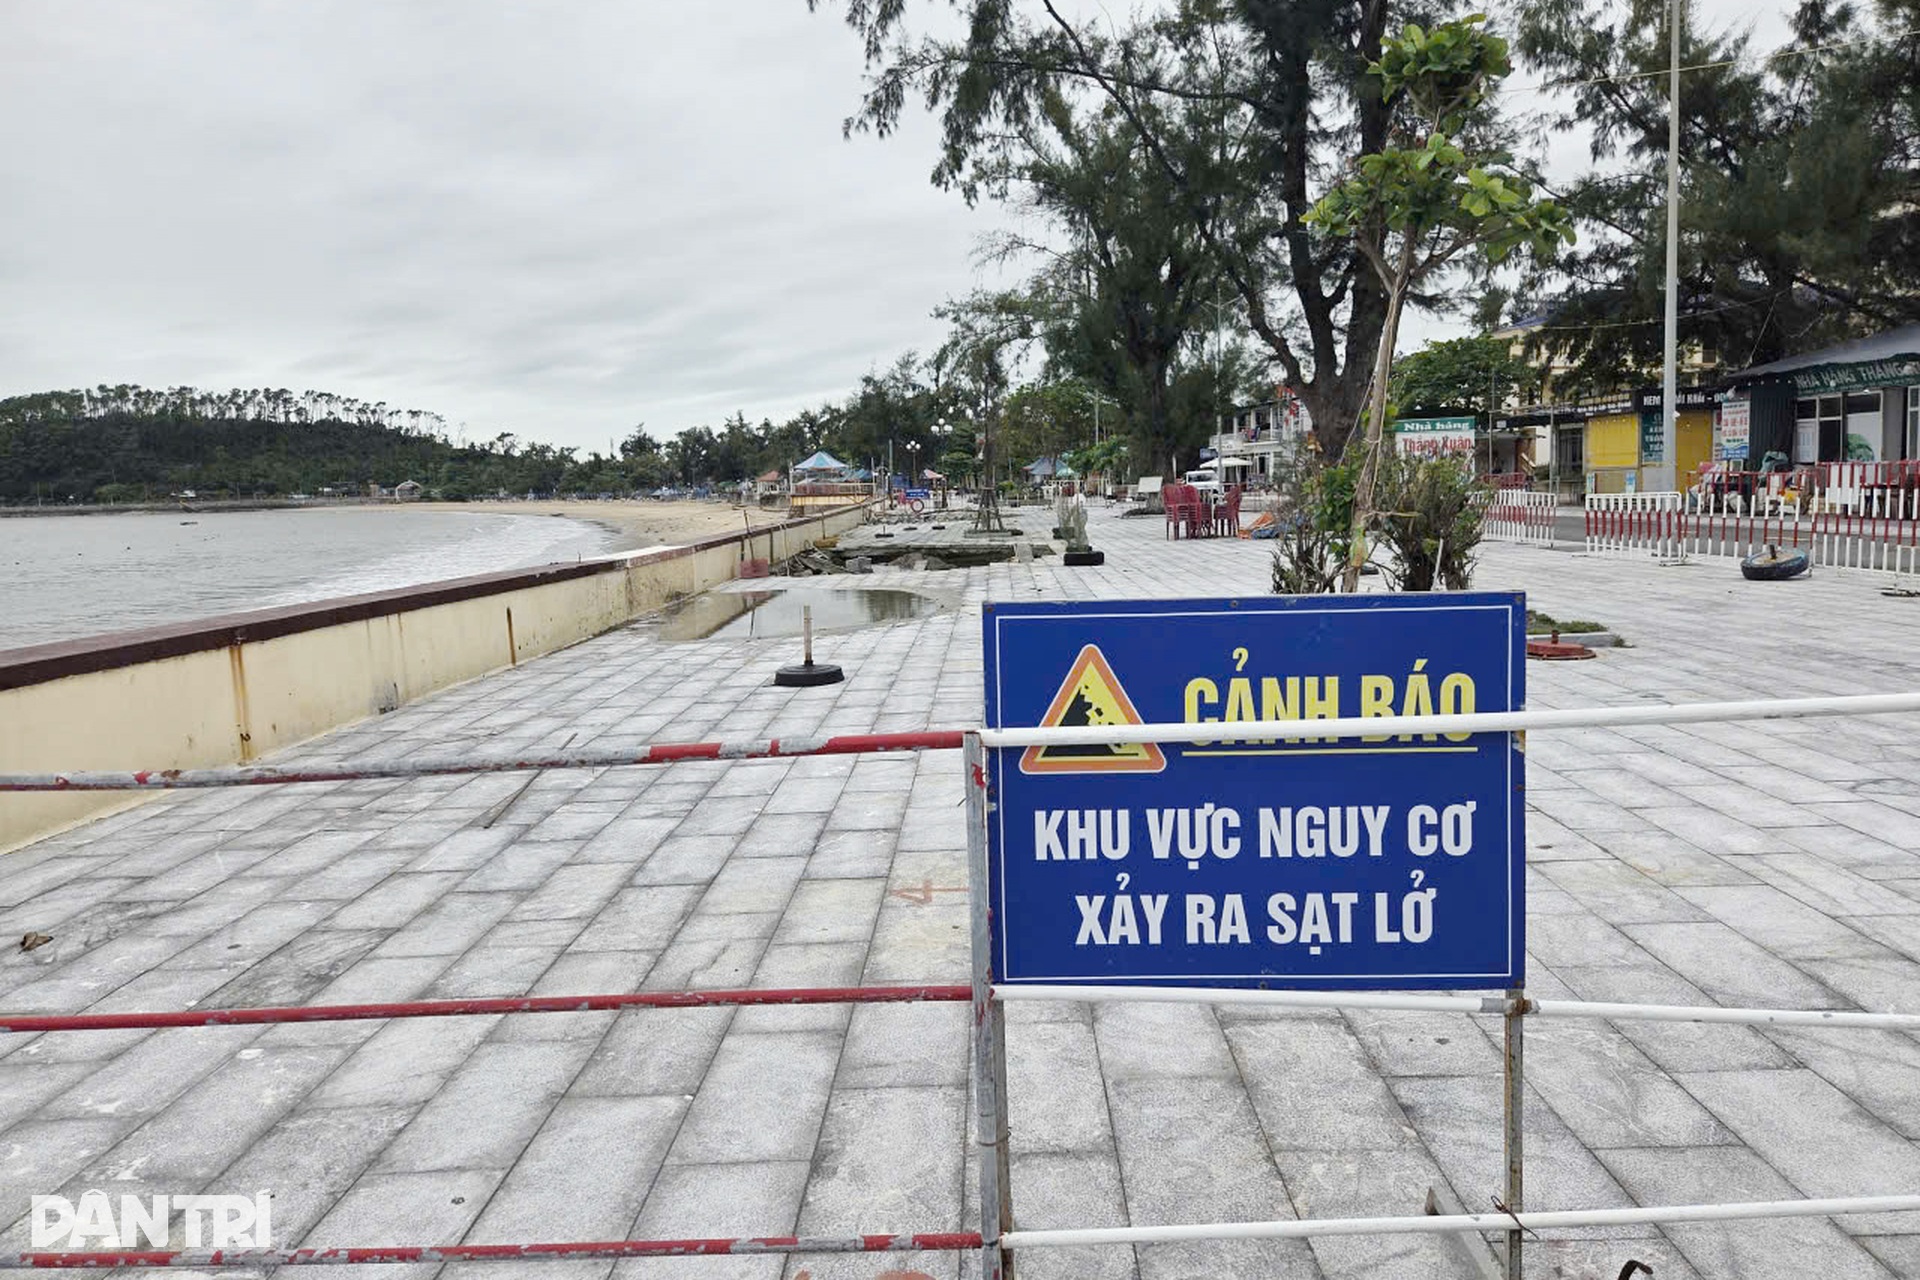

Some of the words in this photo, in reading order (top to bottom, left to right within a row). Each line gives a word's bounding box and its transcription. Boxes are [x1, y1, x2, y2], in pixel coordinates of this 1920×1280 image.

[1403, 421, 1432, 431] Nhà
[1184, 647, 1339, 747] CẢNH
[1361, 658, 1476, 742] BÁO
[1034, 808, 1130, 861] KHU
[1146, 802, 1241, 870] VỰC
[1259, 805, 1391, 859] NGUY
[1407, 800, 1477, 857] CƠ
[1075, 872, 1170, 945] XẢY
[1186, 894, 1250, 944] RA
[1267, 892, 1358, 955] SẠT
[1375, 869, 1437, 944] LỞ
